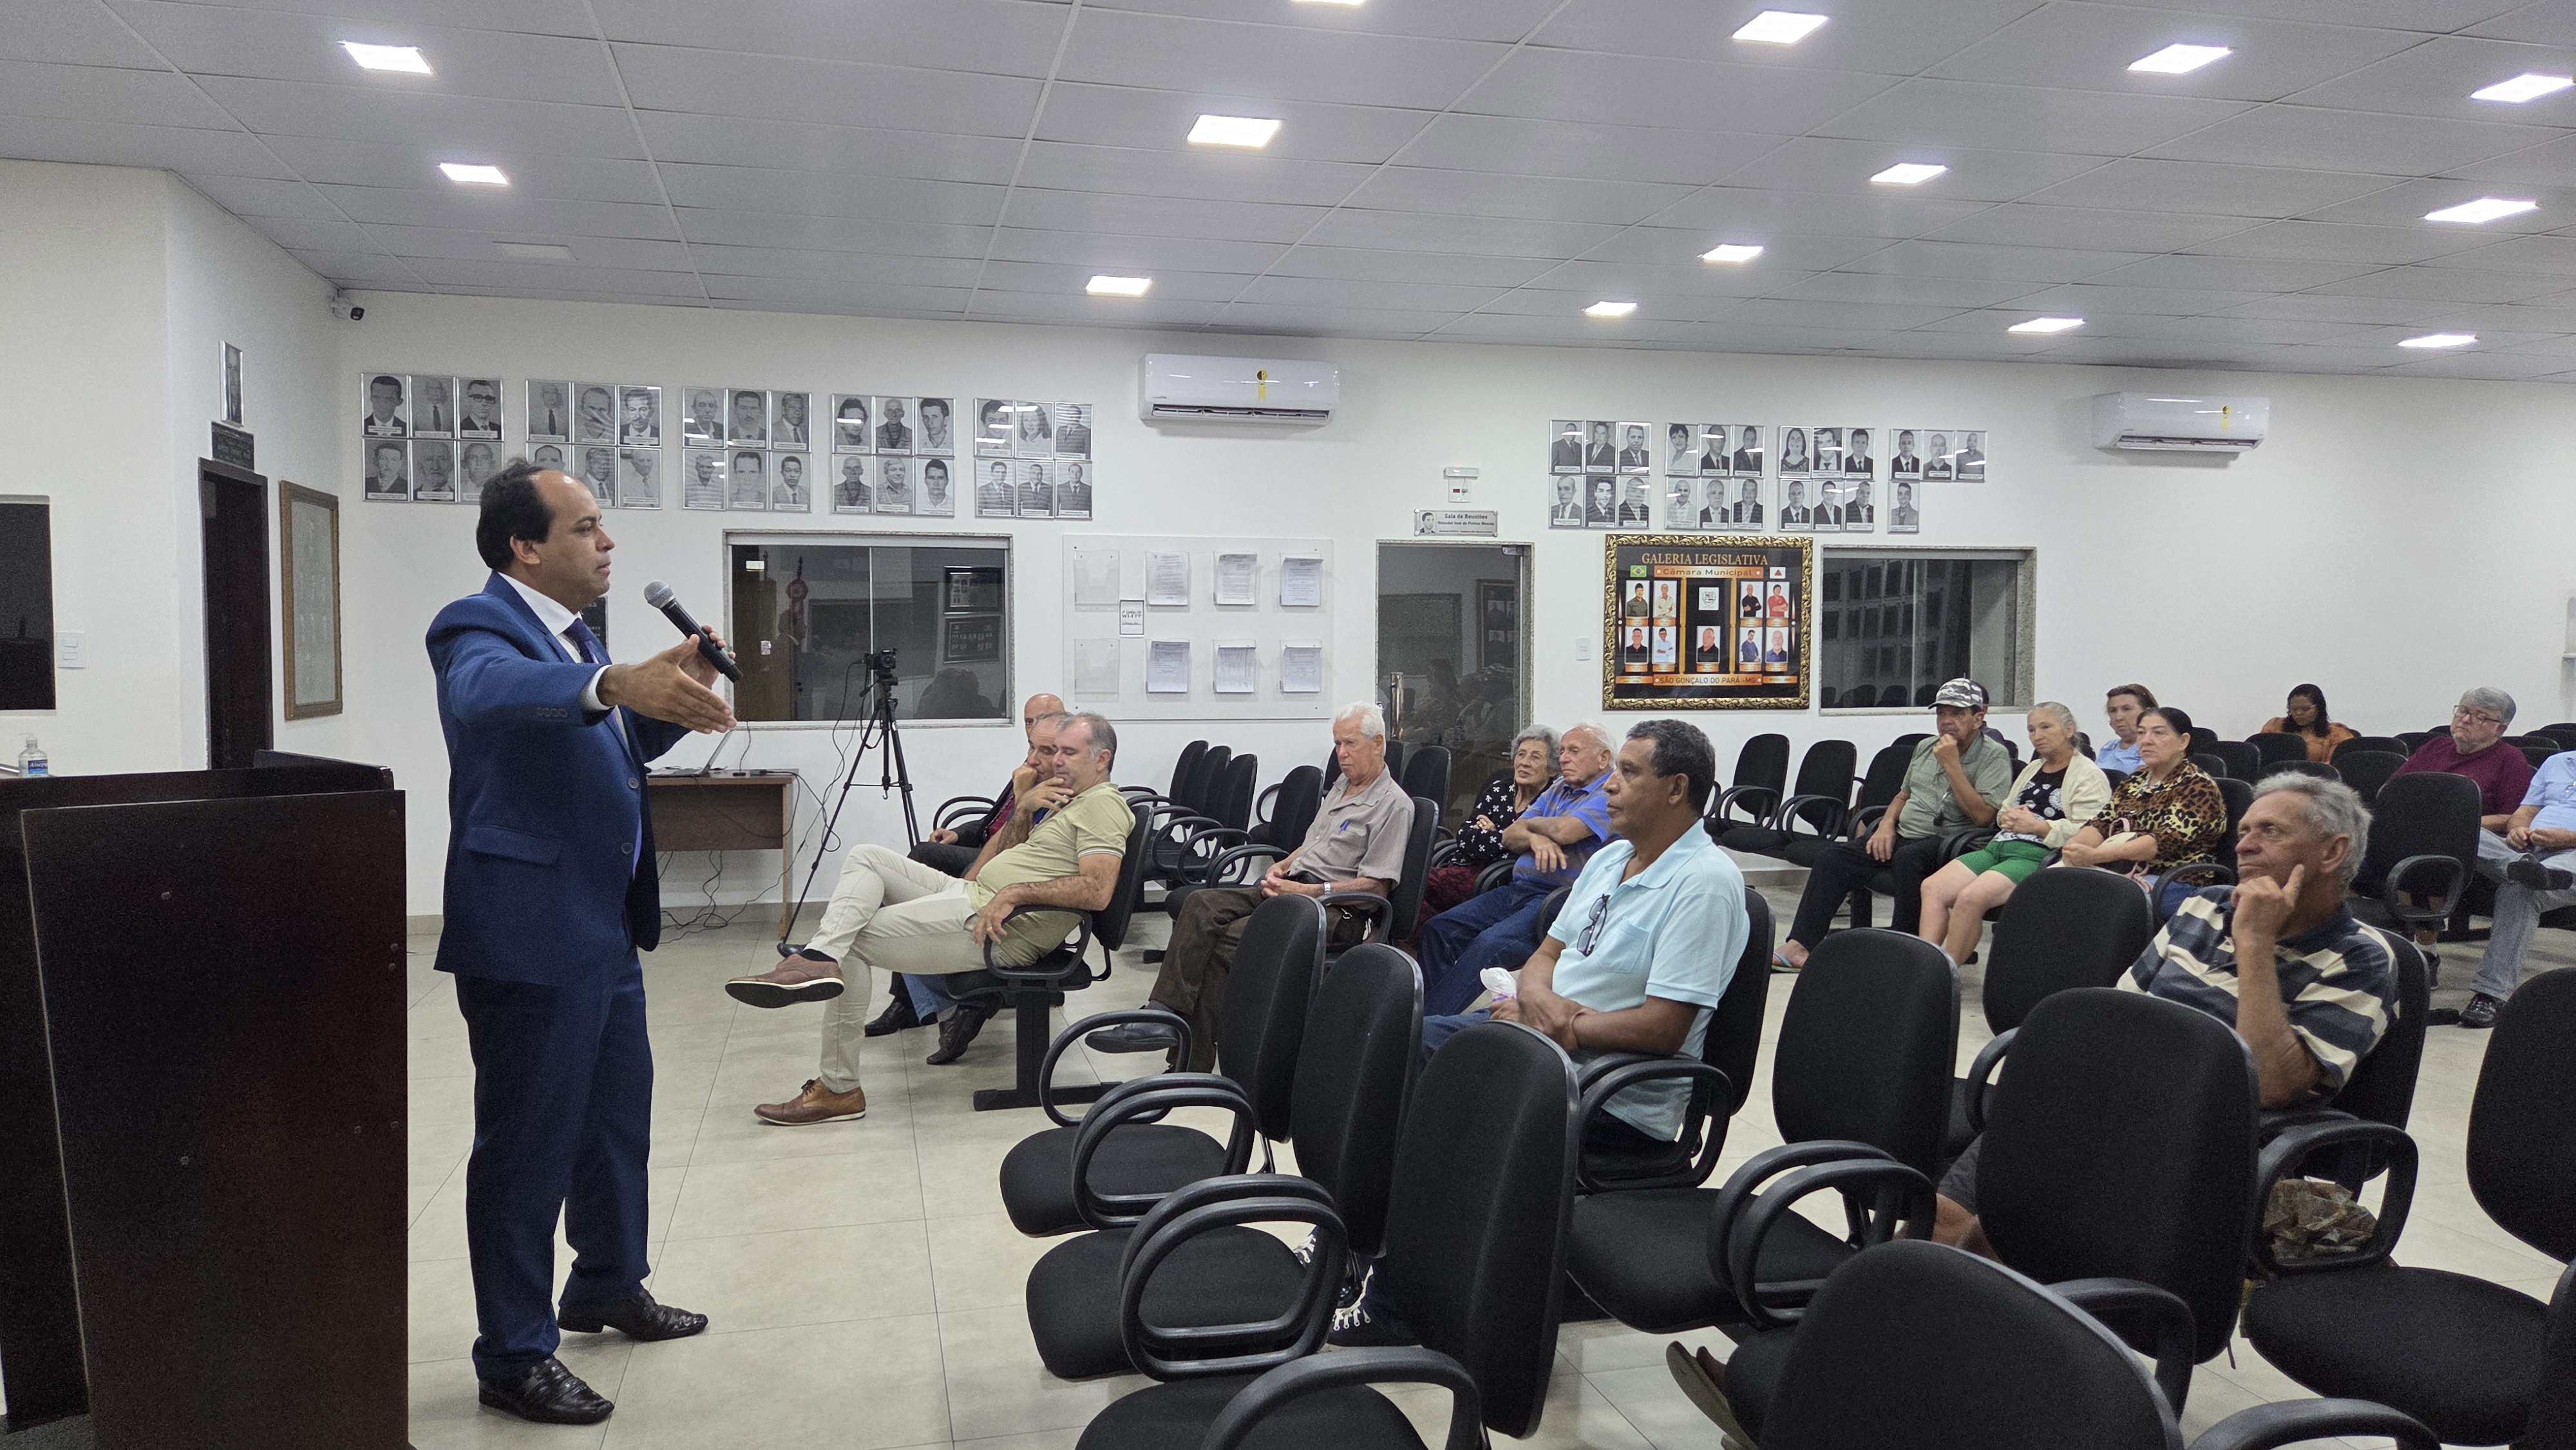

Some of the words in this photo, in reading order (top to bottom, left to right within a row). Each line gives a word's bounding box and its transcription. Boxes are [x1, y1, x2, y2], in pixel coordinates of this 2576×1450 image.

[1642, 553, 1692, 565] GALERIA
[1695, 554, 1768, 565] LEGISLATIVA
[1663, 567, 1701, 576] Câmara
[1705, 569, 1752, 577] Municipal
